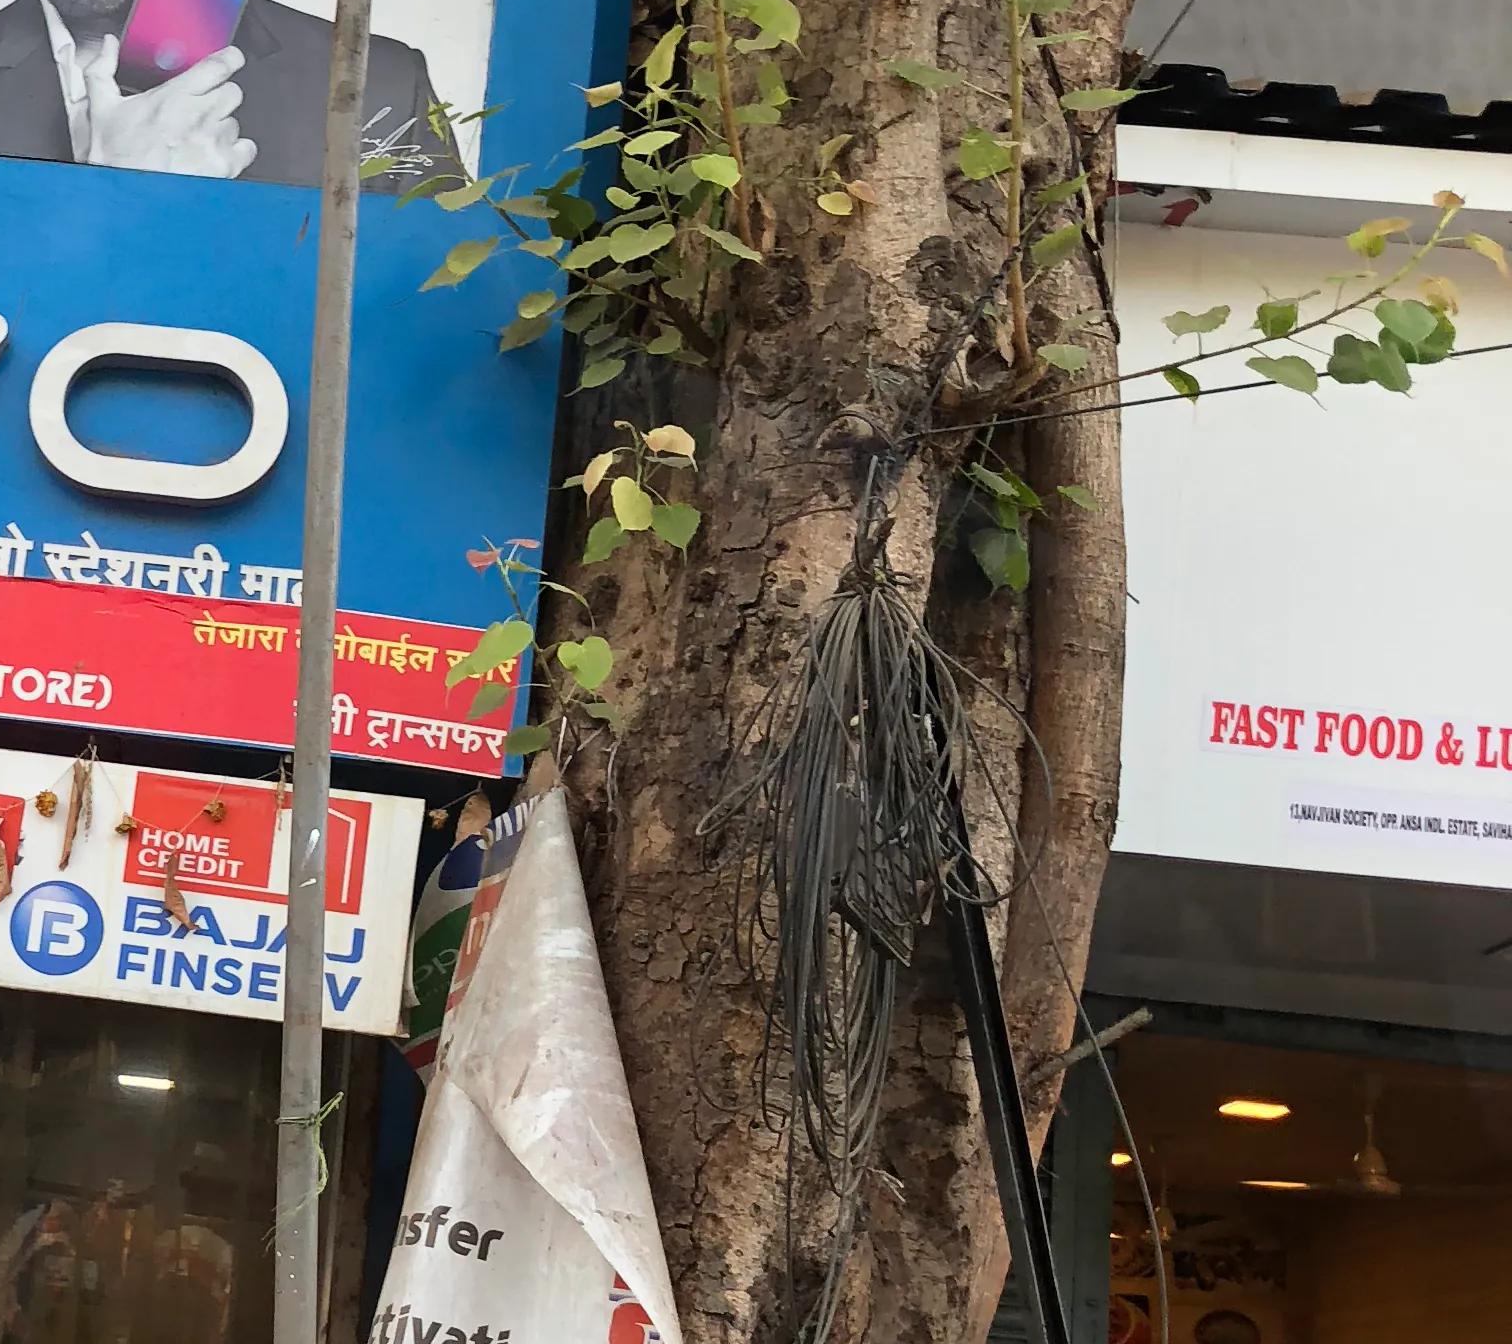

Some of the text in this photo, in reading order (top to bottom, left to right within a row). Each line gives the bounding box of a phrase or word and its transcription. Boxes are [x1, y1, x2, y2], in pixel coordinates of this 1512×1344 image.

[191, 609, 288, 654] तेजारा
[1209, 700, 1306, 750] FAST
[1313, 710, 1425, 762] FOOD
[1435, 721, 1464, 766] &
[136, 849, 245, 881] CREDIT
[139, 826, 231, 857] HOME
[122, 896, 366, 965] BAJJ
[116, 944, 364, 1013] FINSEV
